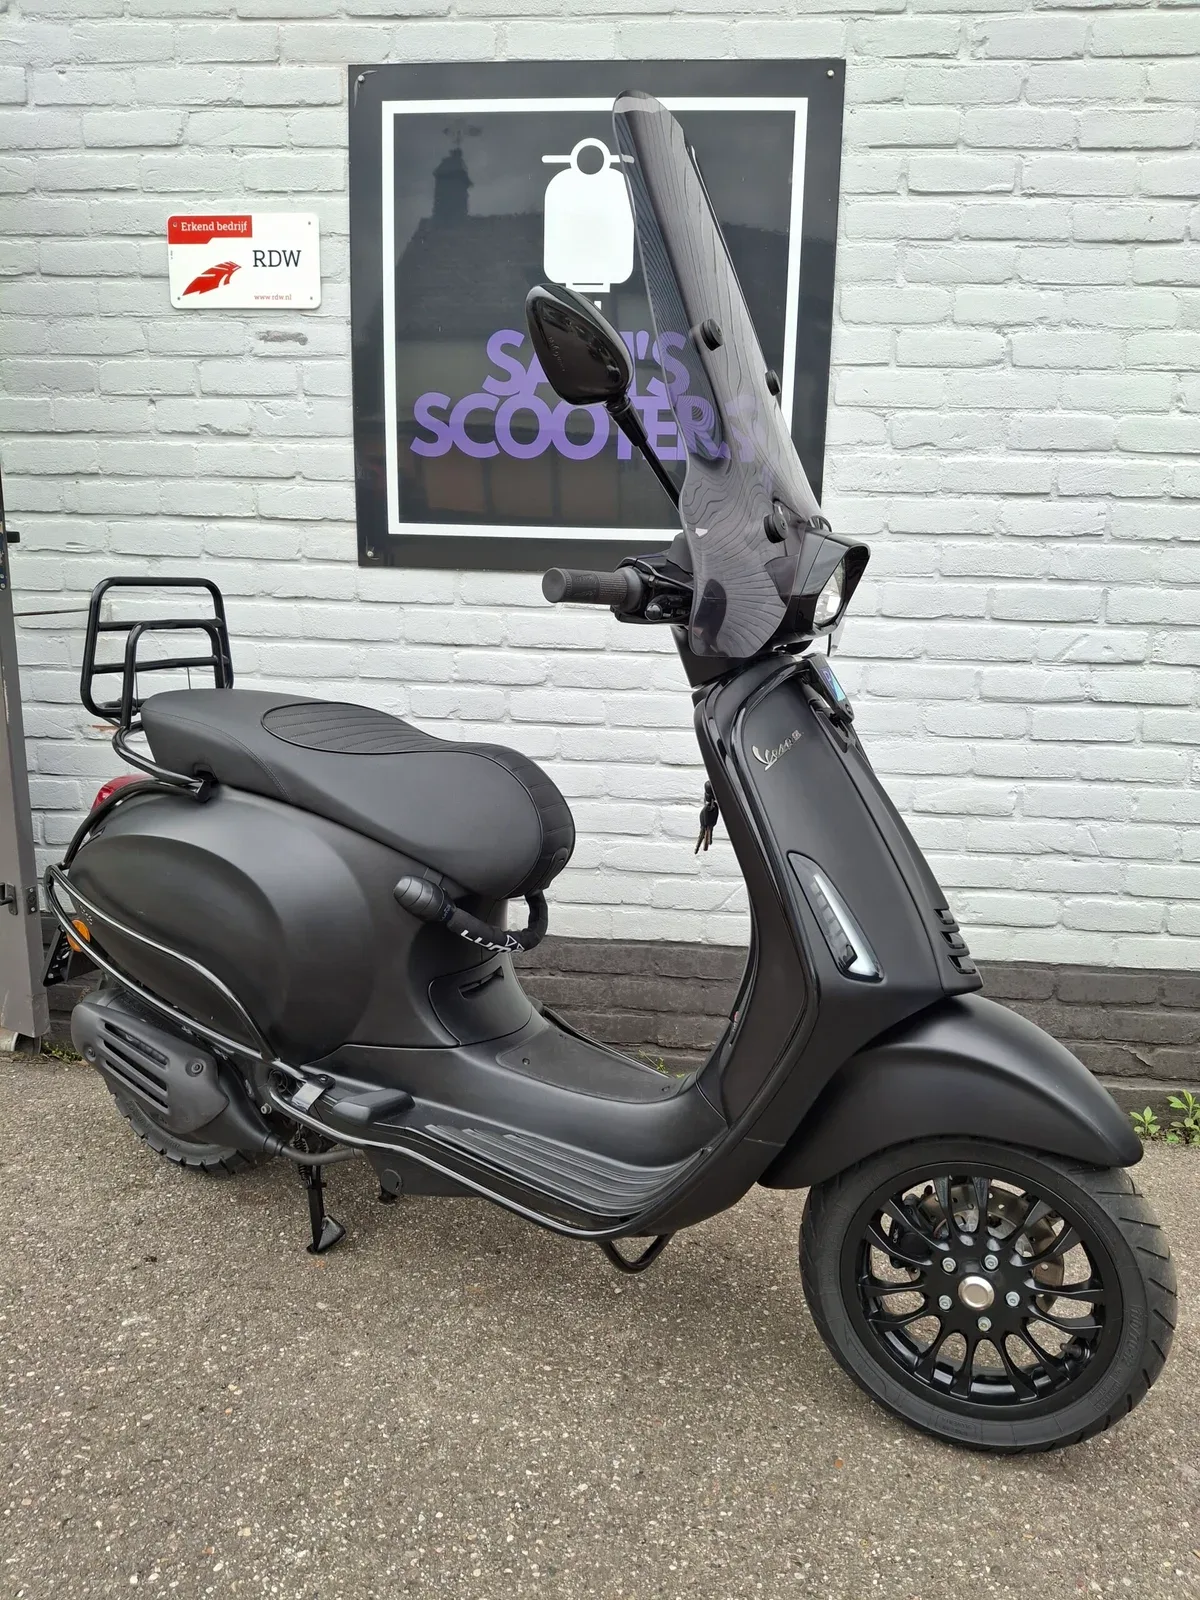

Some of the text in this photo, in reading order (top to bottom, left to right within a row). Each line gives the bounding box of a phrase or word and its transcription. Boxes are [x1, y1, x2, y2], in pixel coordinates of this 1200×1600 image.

[181, 221, 248, 233] Erkend bedrijf
[252, 249, 302, 268] RDW
[254, 293, 292, 301] www.rdw.nl
[482, 329, 690, 396] S'S
